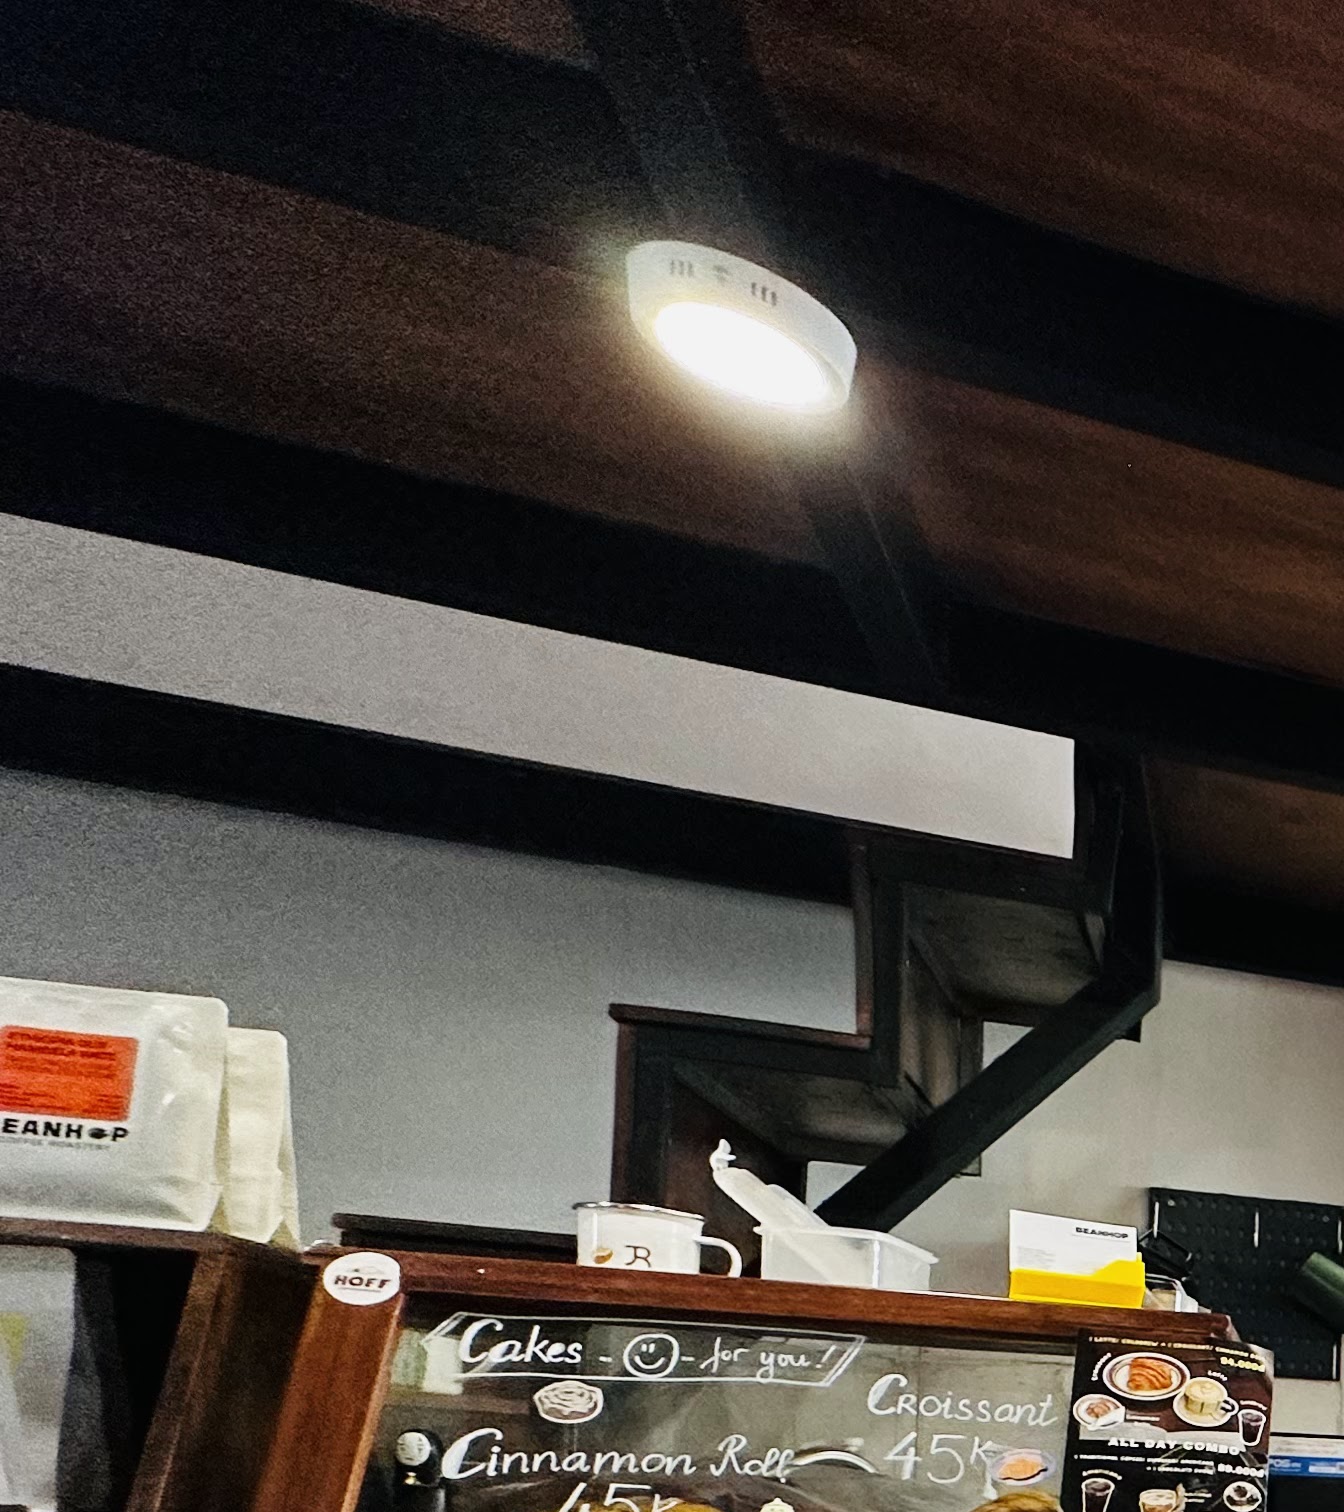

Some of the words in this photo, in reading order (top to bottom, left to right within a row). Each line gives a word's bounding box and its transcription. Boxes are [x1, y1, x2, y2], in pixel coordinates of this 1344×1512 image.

[0, 1118, 130, 1142] EANHOP
[333, 1274, 392, 1289] HOFF
[457, 1317, 584, 1365] Cakes
[700, 1336, 749, 1374] for
[441, 1427, 698, 1480] Cinnamon
[1107, 1437, 1140, 1449] ALL
[1144, 1439, 1178, 1450] DAY
[1181, 1441, 1242, 1456] COMBO
